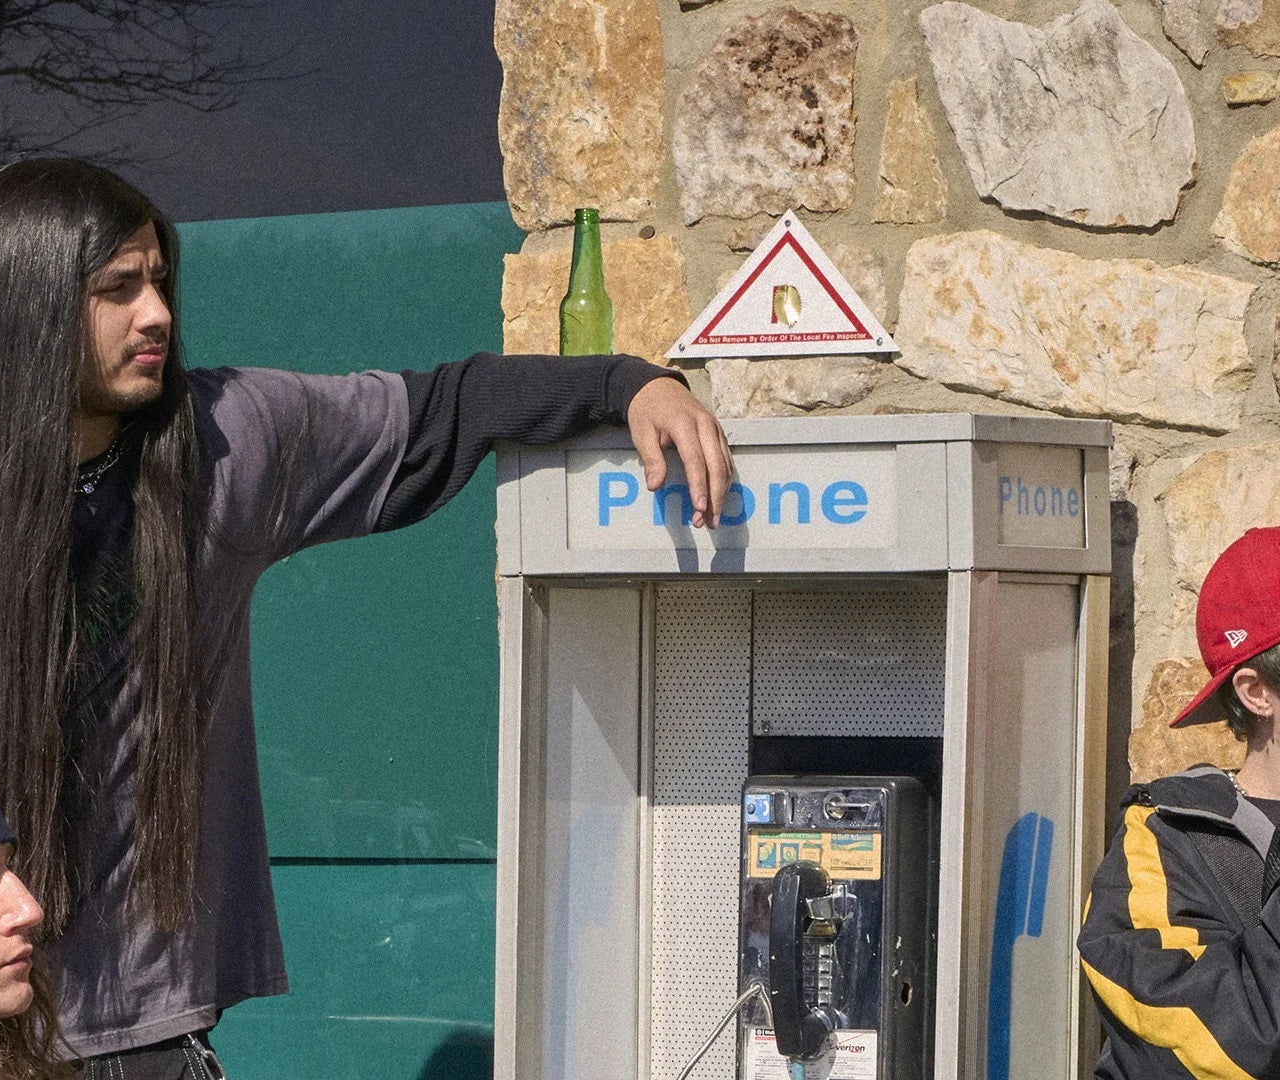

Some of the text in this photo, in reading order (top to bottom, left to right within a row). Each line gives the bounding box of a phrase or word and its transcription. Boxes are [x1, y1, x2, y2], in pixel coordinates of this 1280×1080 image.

[698, 336, 708, 344] Do
[722, 335, 748, 343] Remove
[749, 335, 758, 343] By
[779, 334, 788, 342] Of
[836, 332, 867, 341] Inspector
[998, 476, 1080, 518] Phone
[835, 1044, 866, 1053] verizon
